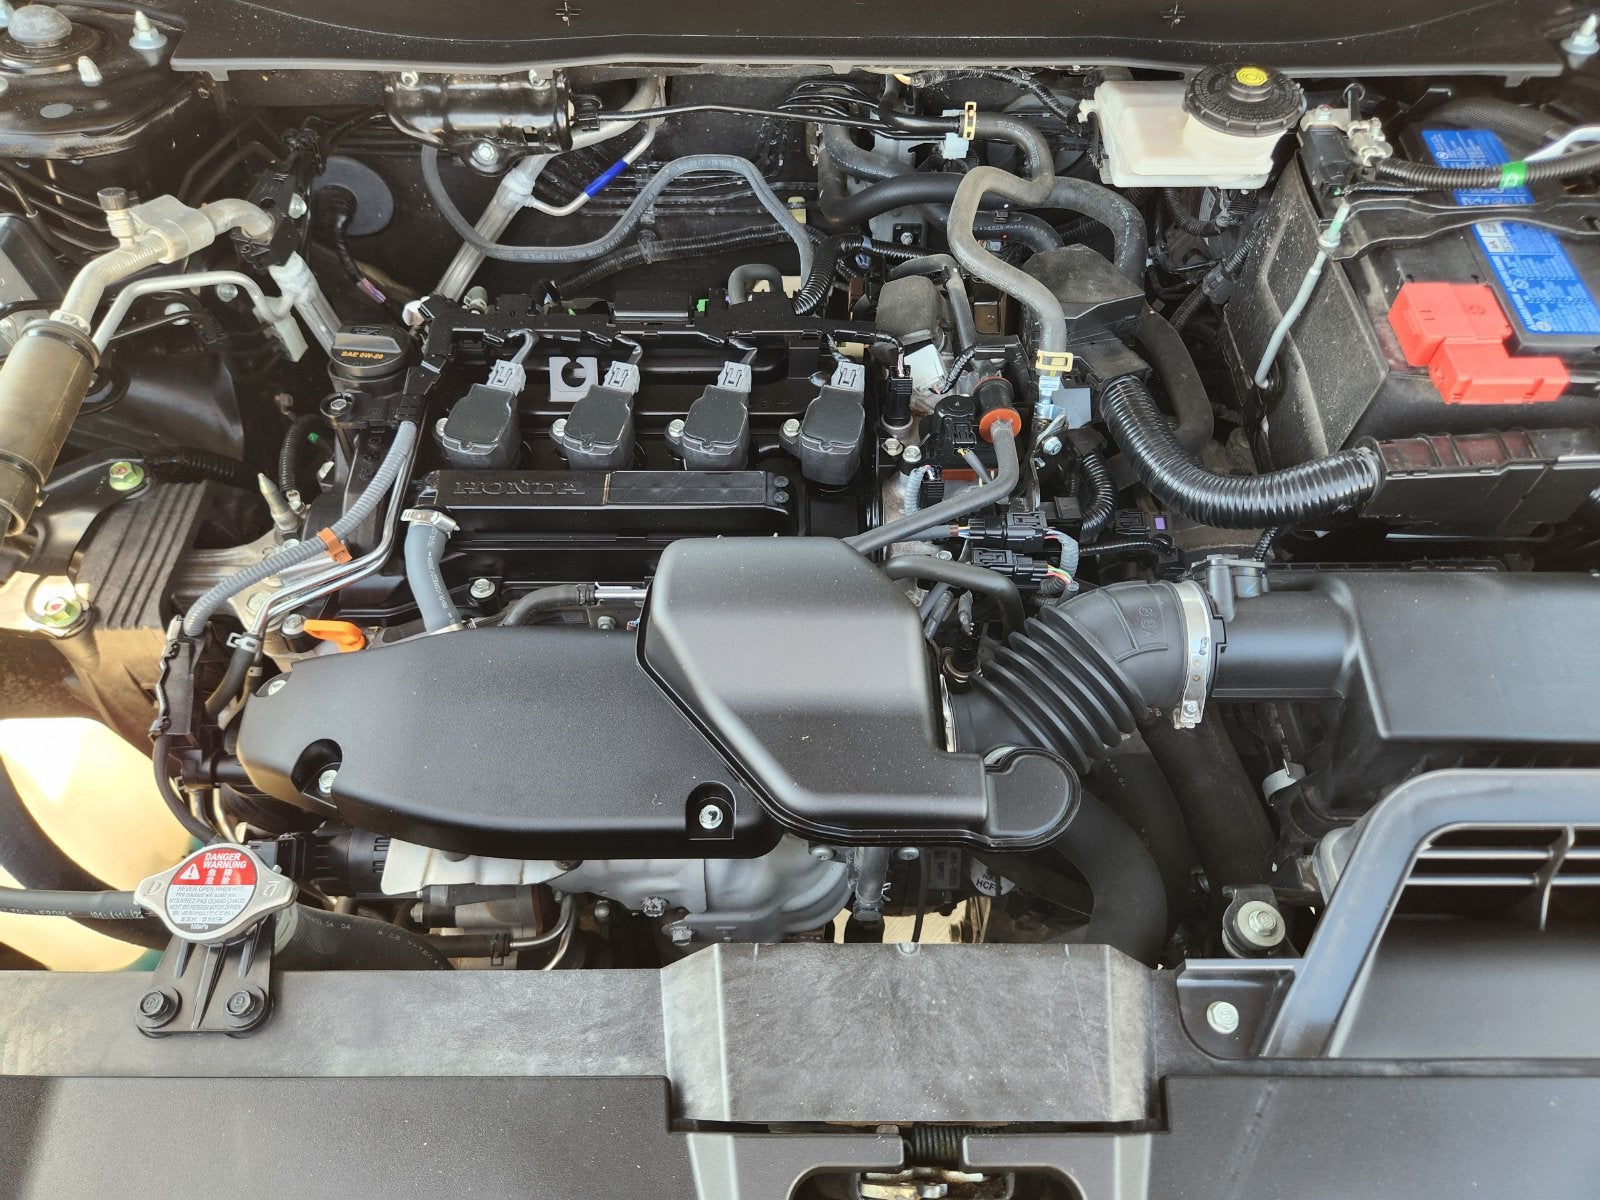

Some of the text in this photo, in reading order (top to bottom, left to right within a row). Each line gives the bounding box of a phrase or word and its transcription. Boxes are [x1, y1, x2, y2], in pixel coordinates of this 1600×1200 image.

[360, 352, 384, 360] 0W-20
[453, 482, 586, 495] HONDA
[205, 853, 242, 861] DANGER
[203, 860, 247, 869] WARNUNG
